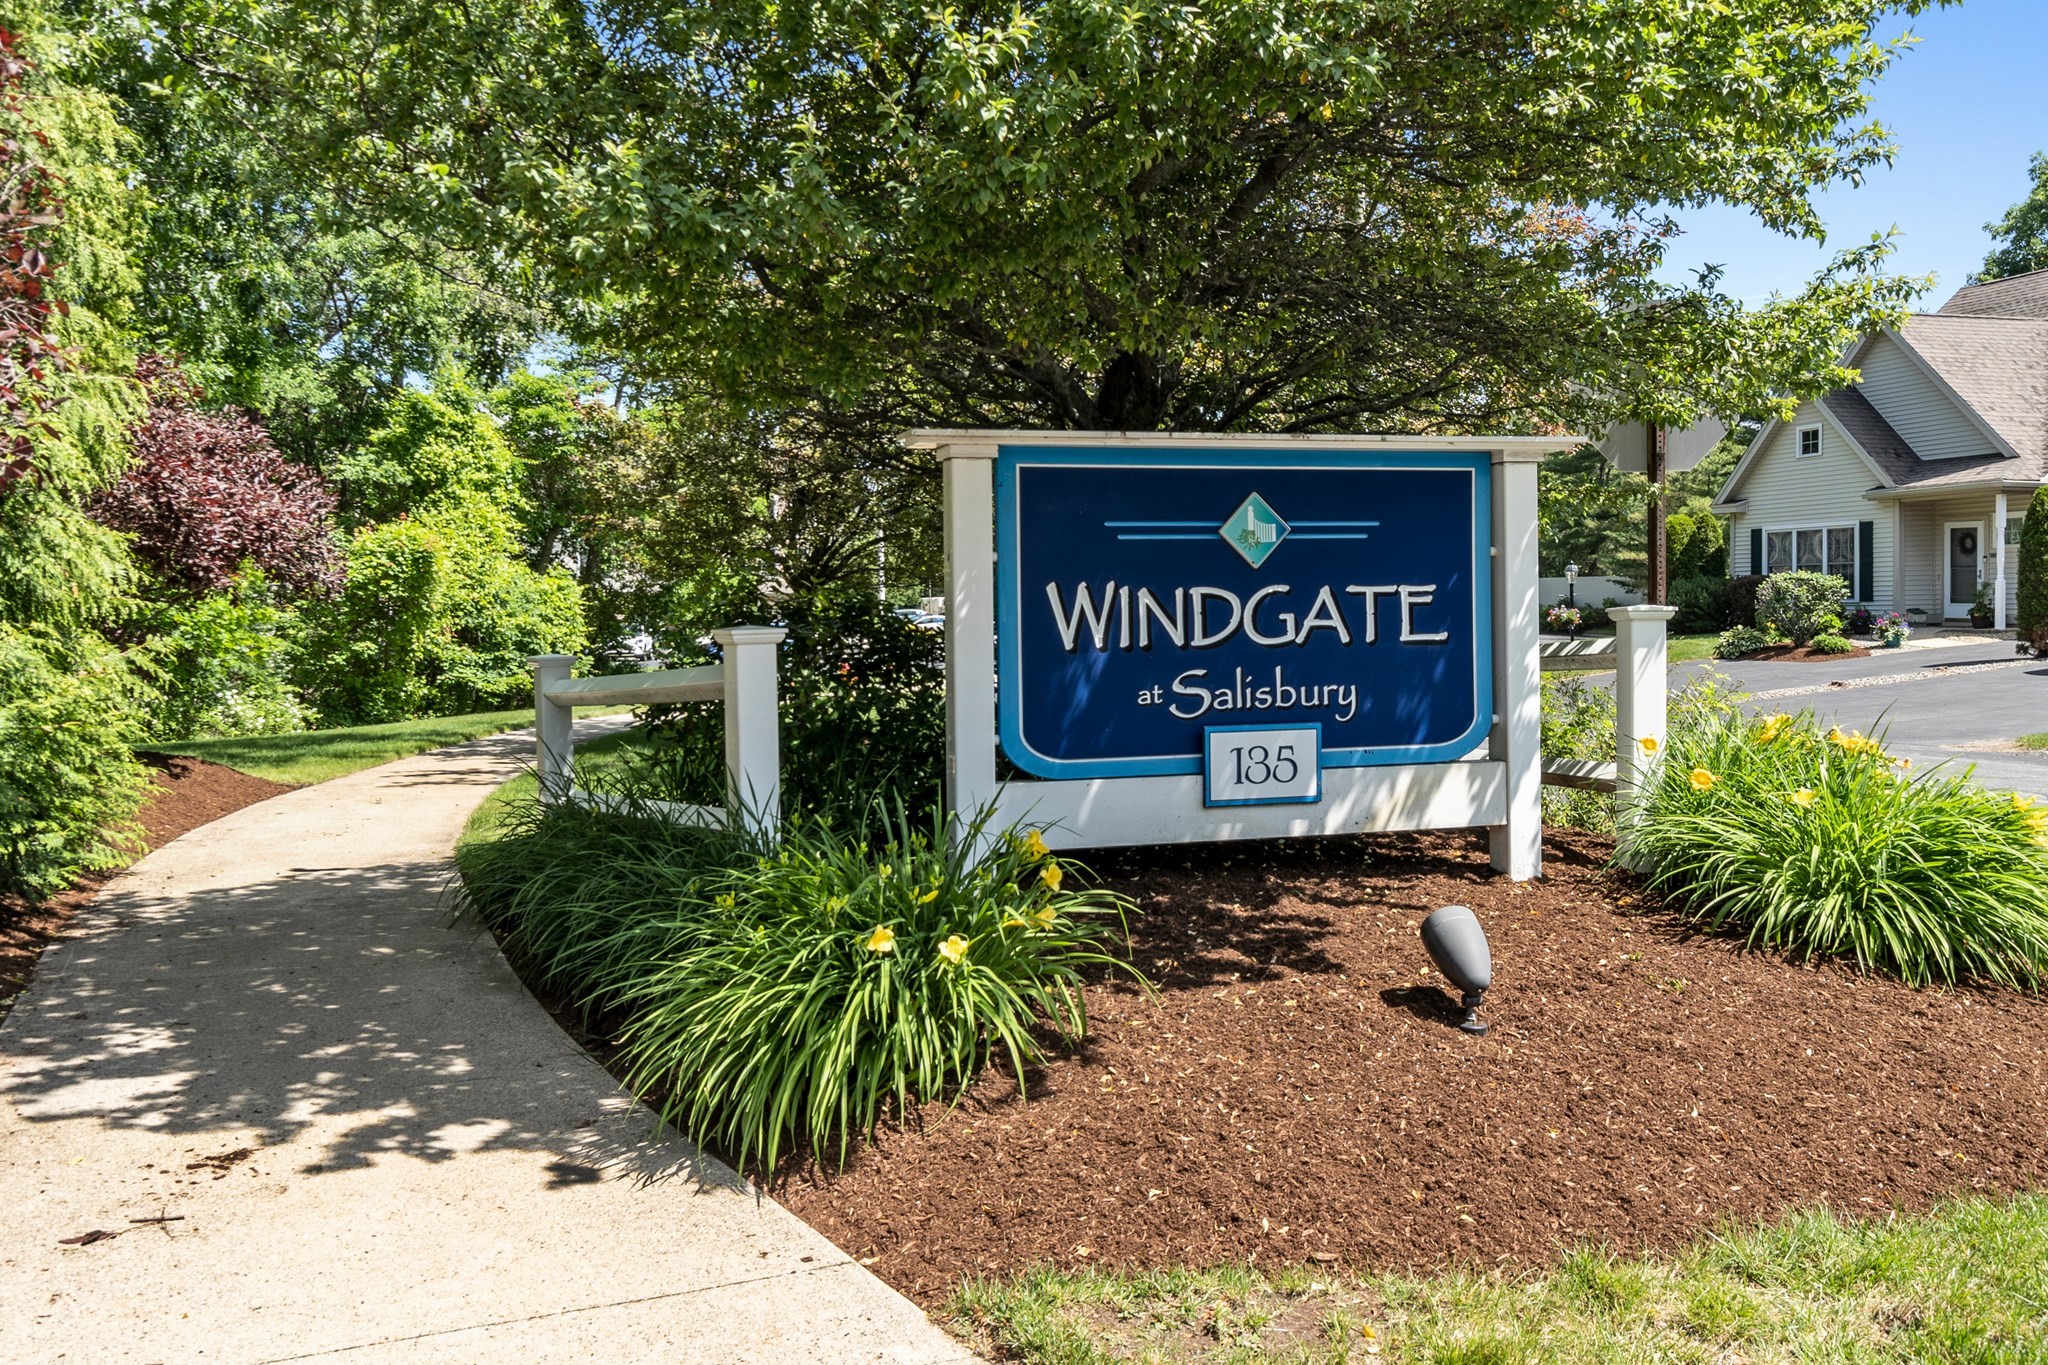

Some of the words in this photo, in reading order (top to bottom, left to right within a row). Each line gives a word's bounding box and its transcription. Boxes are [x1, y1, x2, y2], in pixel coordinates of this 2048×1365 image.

[1046, 580, 1449, 651] WINDGATE
[1136, 685, 1163, 706] at
[1168, 665, 1357, 722] Salisbury
[1229, 745, 1298, 785] 135
